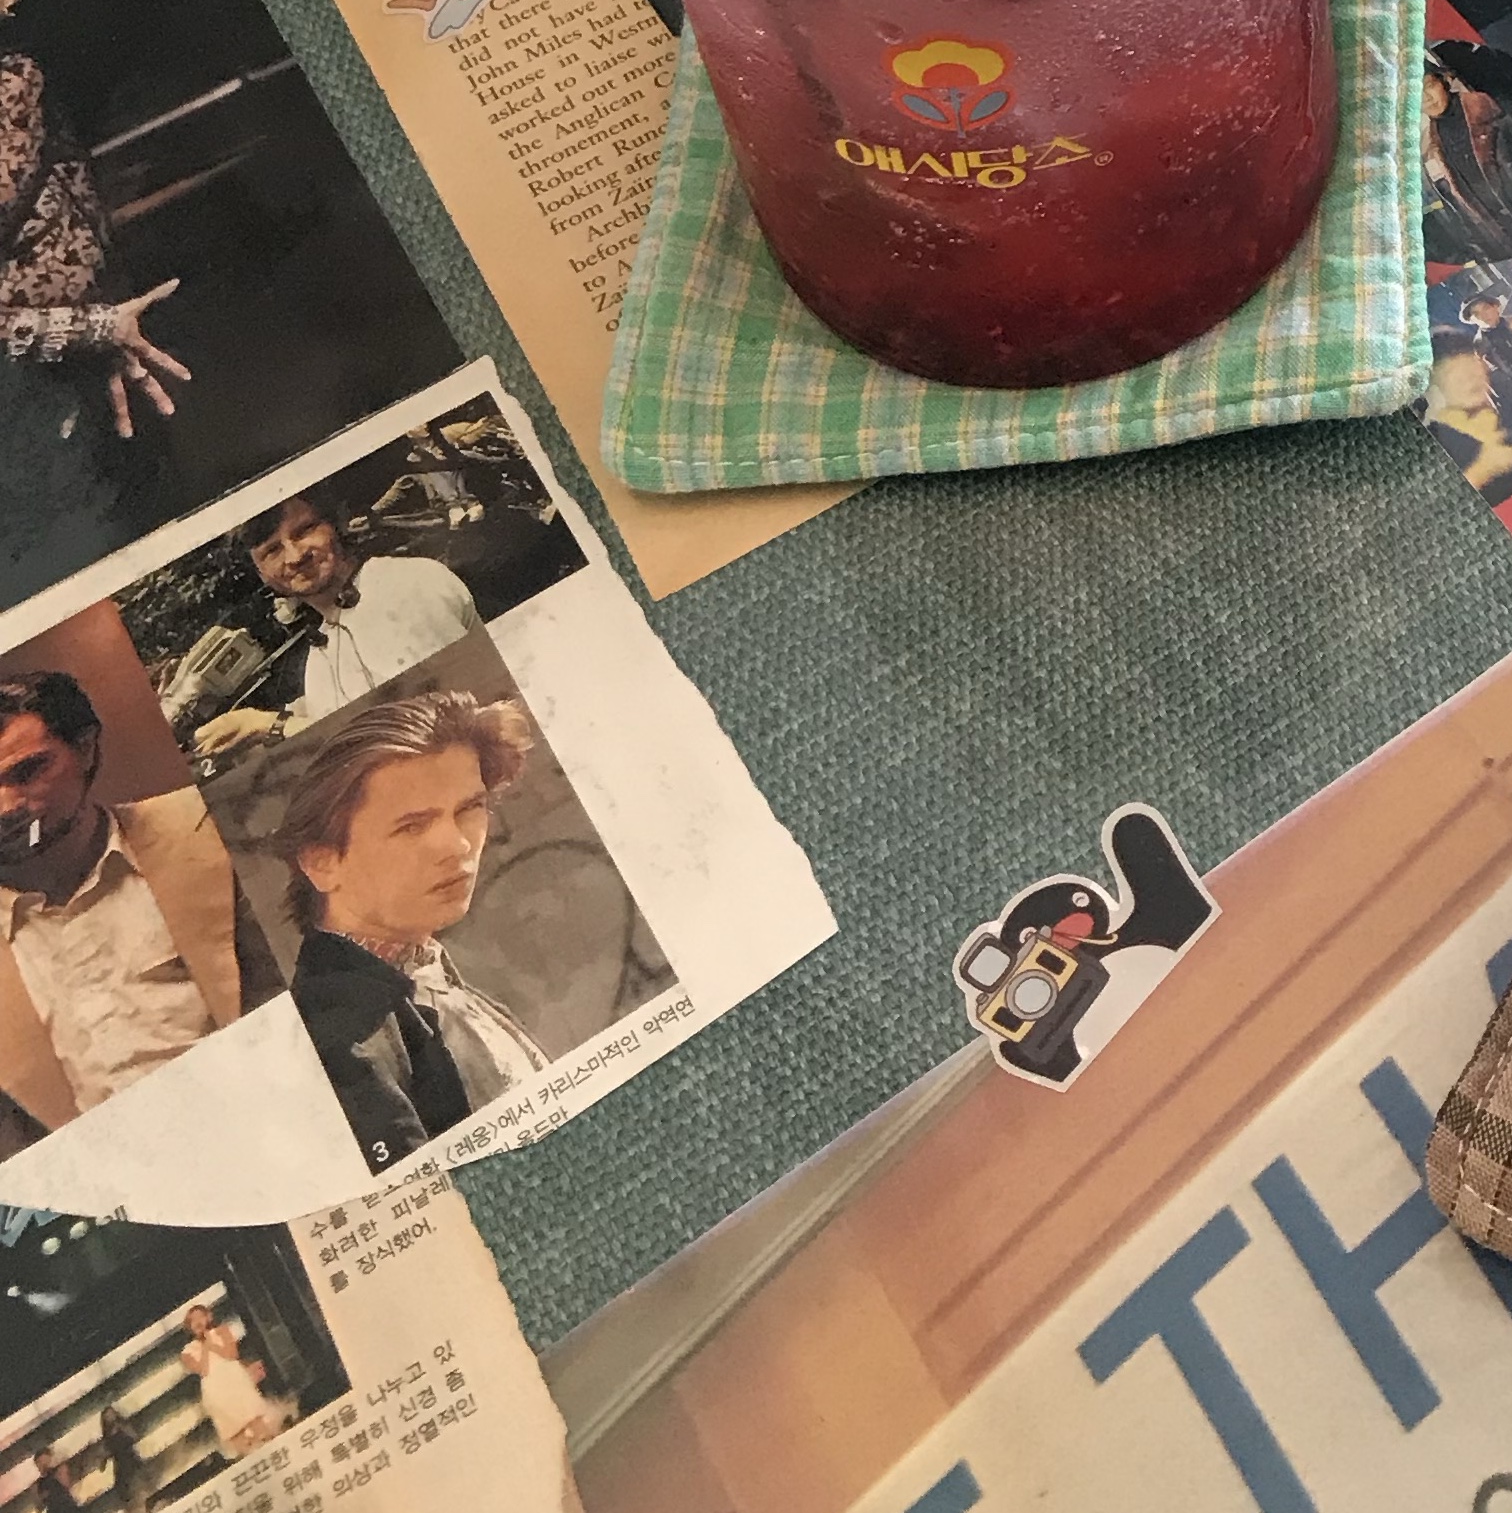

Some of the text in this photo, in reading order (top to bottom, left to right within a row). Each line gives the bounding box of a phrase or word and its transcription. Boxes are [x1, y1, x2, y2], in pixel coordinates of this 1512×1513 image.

[447, 28, 490, 53] that
[498, 0, 551, 30] there
[458, 45, 492, 71] did
[503, 26, 540, 50] not
[547, 0, 597, 28] have
[466, 60, 518, 92] John
[523, 29, 582, 62] Miles
[586, 5, 627, 32] had
[475, 52, 580, 106] House in
[487, 47, 637, 124] asked to liaise
[498, 95, 575, 140] worked
[581, 79, 617, 102] out
[622, 51, 675, 83] more
[507, 89, 644, 160] the Anglican
[527, 155, 603, 197] Robert
[834, 132, 1094, 189] 애시당초
[537, 170, 621, 216] looking
[549, 203, 603, 235] from
[587, 203, 650, 242] Archb
[568, 233, 640, 273] before
[582, 274, 606, 292] to
[200, 757, 217, 779] 2
[537, 1030, 640, 1104] 카리스마적인
[642, 995, 695, 1034] 악역연
[370, 1139, 390, 1164] 3
[299, 1403, 357, 1448] 우정을
[366, 1361, 426, 1406] 나누고
[282, 1458, 323, 1495] 위해
[330, 1415, 389, 1463] 특별히
[398, 1384, 437, 1422] 신경
[332, 1449, 390, 1498] 의상과
